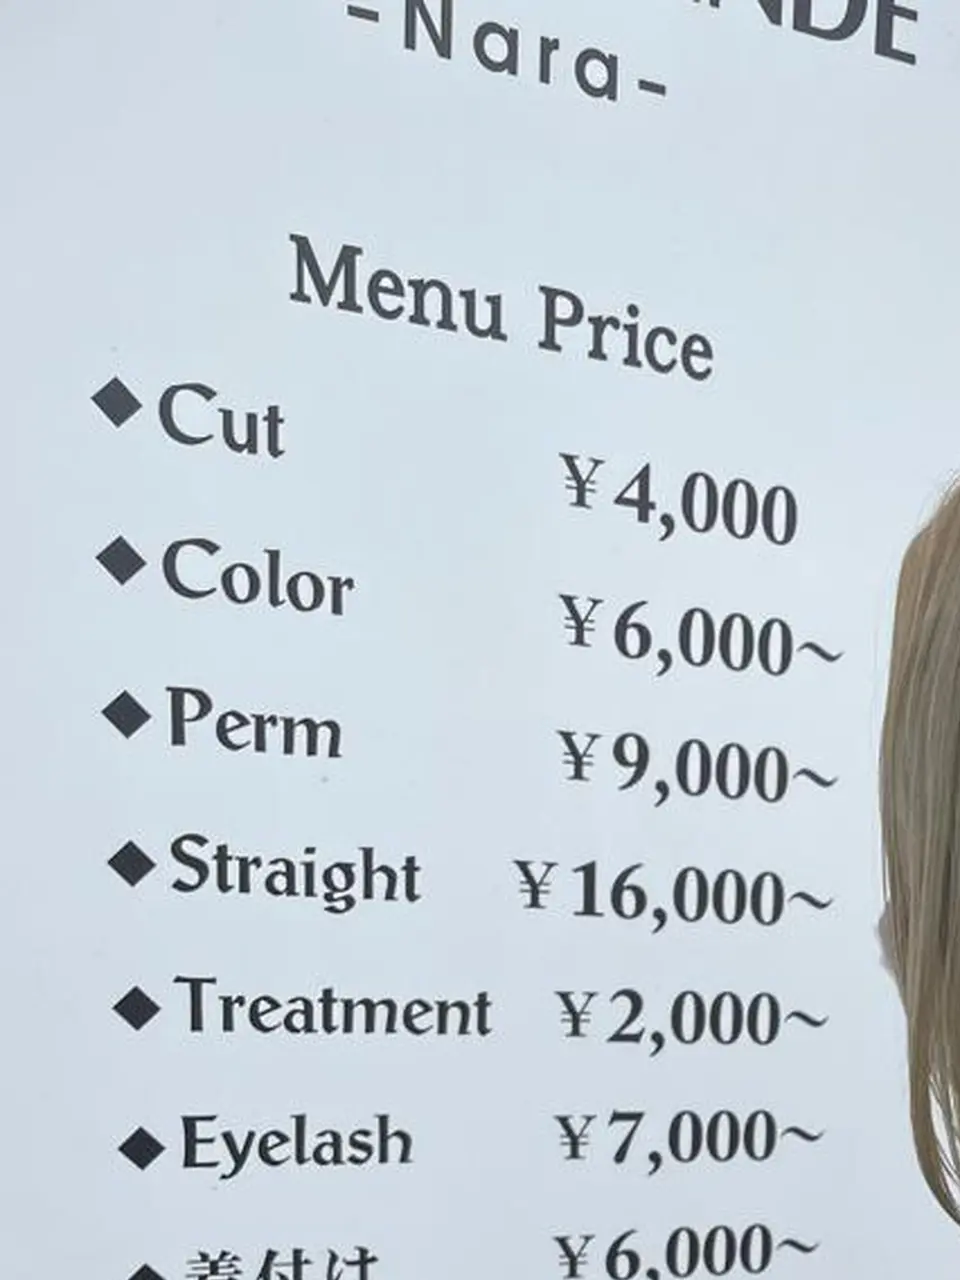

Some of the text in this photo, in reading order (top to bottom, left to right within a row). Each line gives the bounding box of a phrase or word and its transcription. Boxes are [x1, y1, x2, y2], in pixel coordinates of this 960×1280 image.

[288, 233, 714, 382] Menu Price
[158, 382, 286, 459] Cut
[558, 452, 798, 546] ¥4,000
[161, 537, 355, 616] Color
[164, 685, 342, 759] Perm
[170, 832, 422, 915] Straight
[172, 975, 493, 1038] Treatment
[180, 1113, 413, 1181] Eyelash
